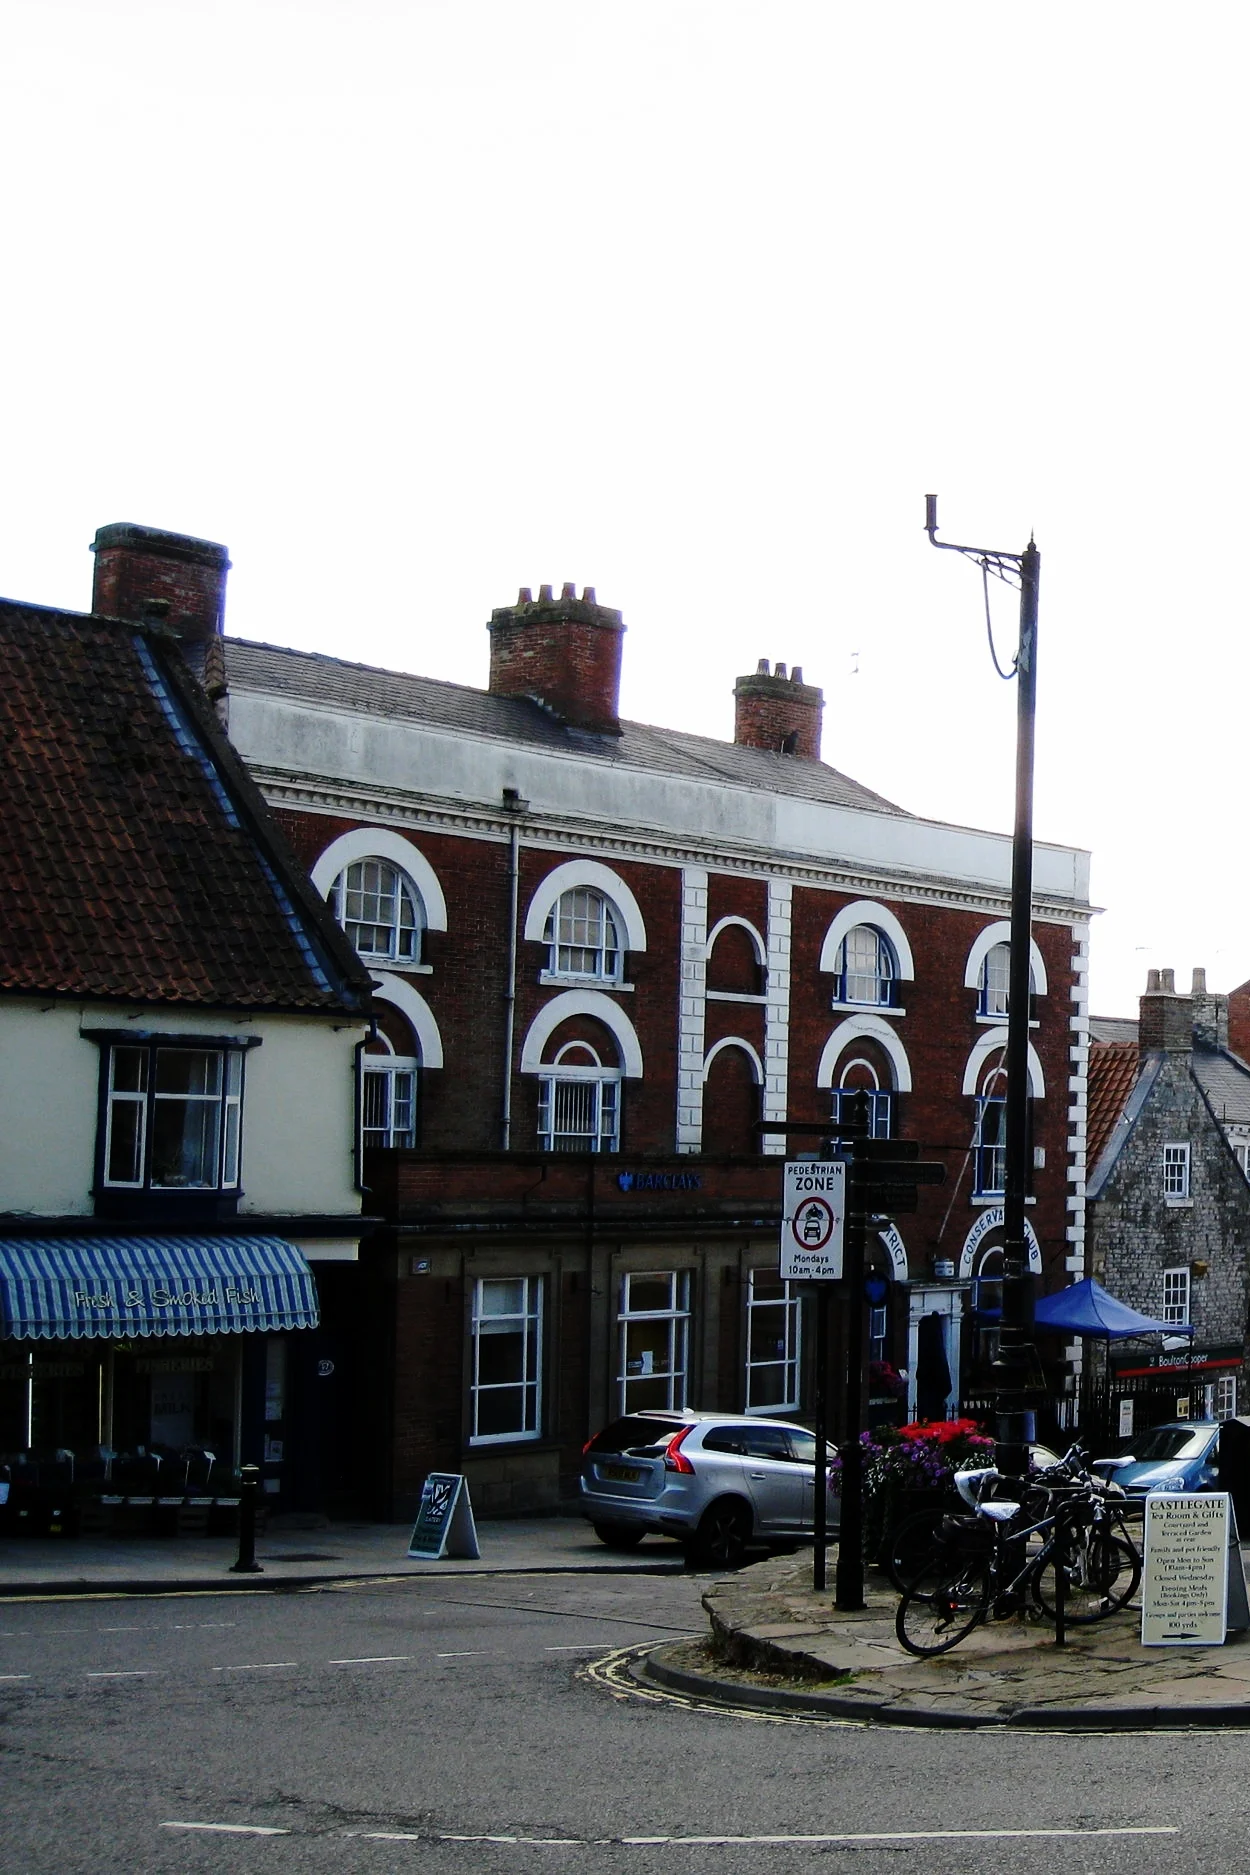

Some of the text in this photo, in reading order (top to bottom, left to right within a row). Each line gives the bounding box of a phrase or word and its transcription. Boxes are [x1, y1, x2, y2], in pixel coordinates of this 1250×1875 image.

[788, 1166, 842, 1175] PEDESTRIAN
[636, 1173, 703, 1190] BARCLAYS
[795, 1177, 834, 1191] ZONE
[963, 1209, 1004, 1265] CONSERVA
[885, 1227, 906, 1267] TRICT
[794, 1254, 829, 1264] Mondays
[75, 1287, 260, 1310] Fresh & Smoked Fish
[1150, 1500, 1224, 1510] CASTLEGATE
[1152, 1512, 1164, 1520] Tea
[1166, 1511, 1190, 1520] Room
[1202, 1510, 1224, 1519] Gifts
[1156, 1557, 1175, 1565] Open
